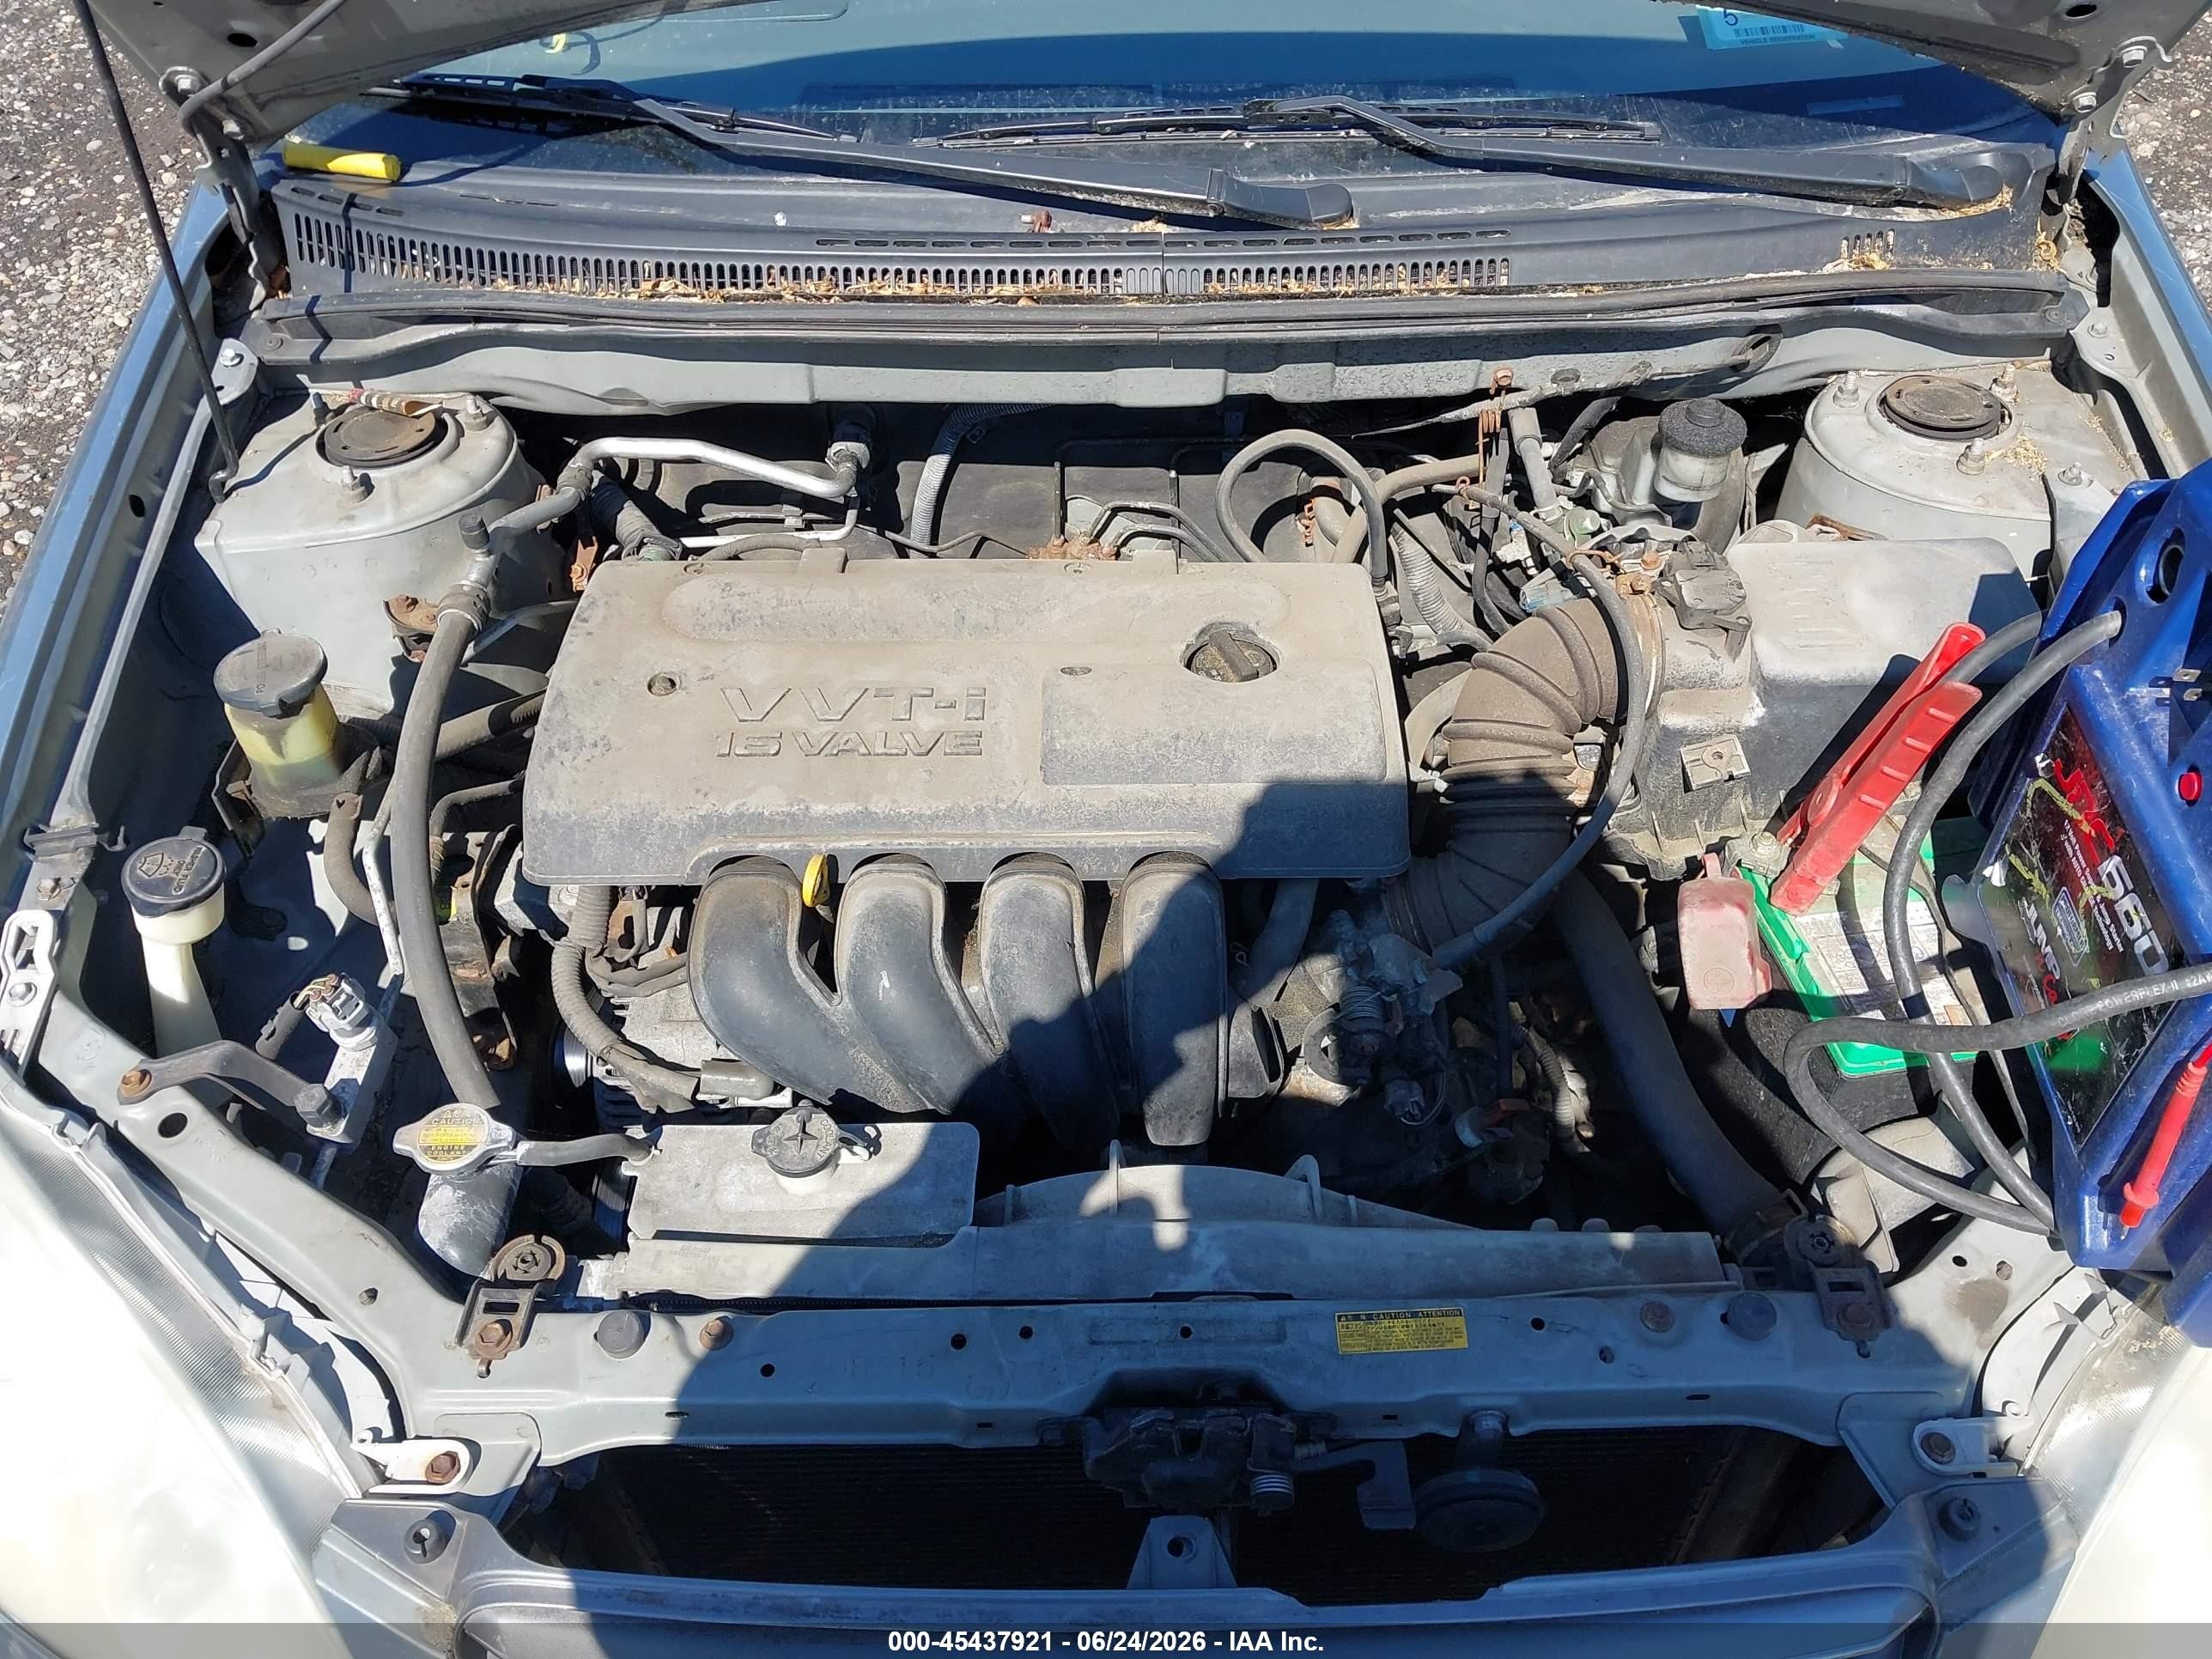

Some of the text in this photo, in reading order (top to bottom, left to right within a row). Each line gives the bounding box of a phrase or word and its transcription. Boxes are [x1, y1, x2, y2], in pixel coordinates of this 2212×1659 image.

[720, 687, 986, 722] VVT-i
[716, 731, 982, 757] 16 VALVE
[2063, 840, 2074, 858] with
[2070, 857, 2082, 877] AUTO
[2092, 907, 2114, 950] Technology
[2067, 830, 2077, 845] Volt
[2073, 844, 2087, 868] Power
[2083, 869, 2099, 896] Supp
[2098, 902, 2112, 926] Jump
[2107, 925, 2124, 952] Starter
[2054, 907, 2077, 957] TECHNOLOG
[431, 1117, 480, 1126] CAUTIO
[817, 1119, 835, 1160] COOLANT
